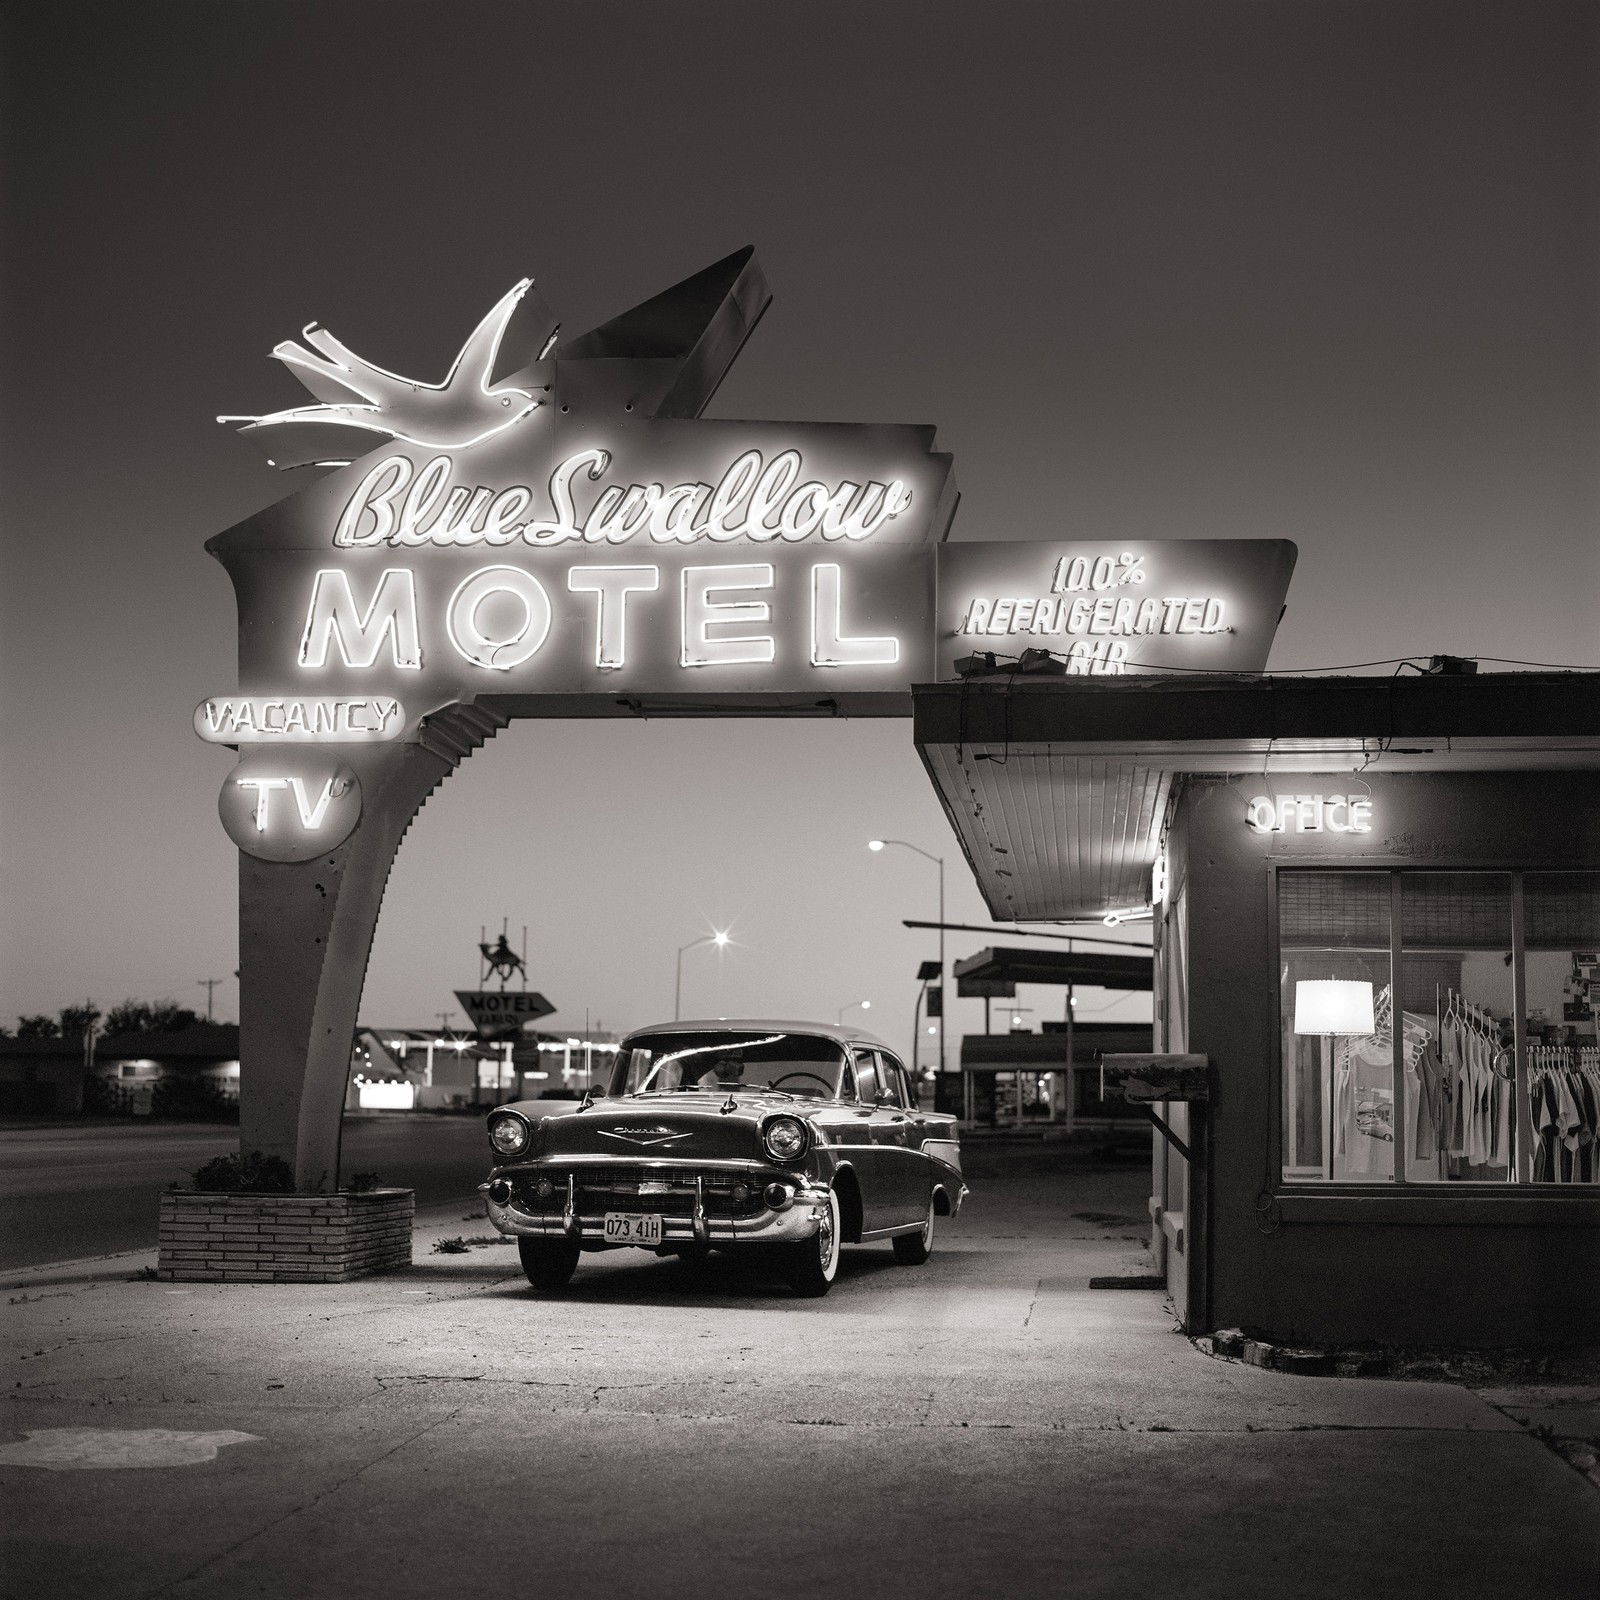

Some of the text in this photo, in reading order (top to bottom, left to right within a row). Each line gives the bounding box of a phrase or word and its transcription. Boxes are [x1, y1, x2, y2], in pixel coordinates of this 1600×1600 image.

[333, 448, 913, 548] Blue Swallow
[1050, 551, 1146, 594] 100%
[298, 563, 900, 671] MOTEL
[962, 597, 1229, 636] REFRIGERATED
[1065, 640, 1129, 675] AIR
[204, 699, 399, 733] VACANCY
[237, 776, 338, 832] TV
[1247, 794, 1373, 834] OFFICE
[470, 995, 541, 1012] MOTEL
[613, 1126, 678, 1135] Chevro
[606, 1219, 659, 1238] 073 41H
